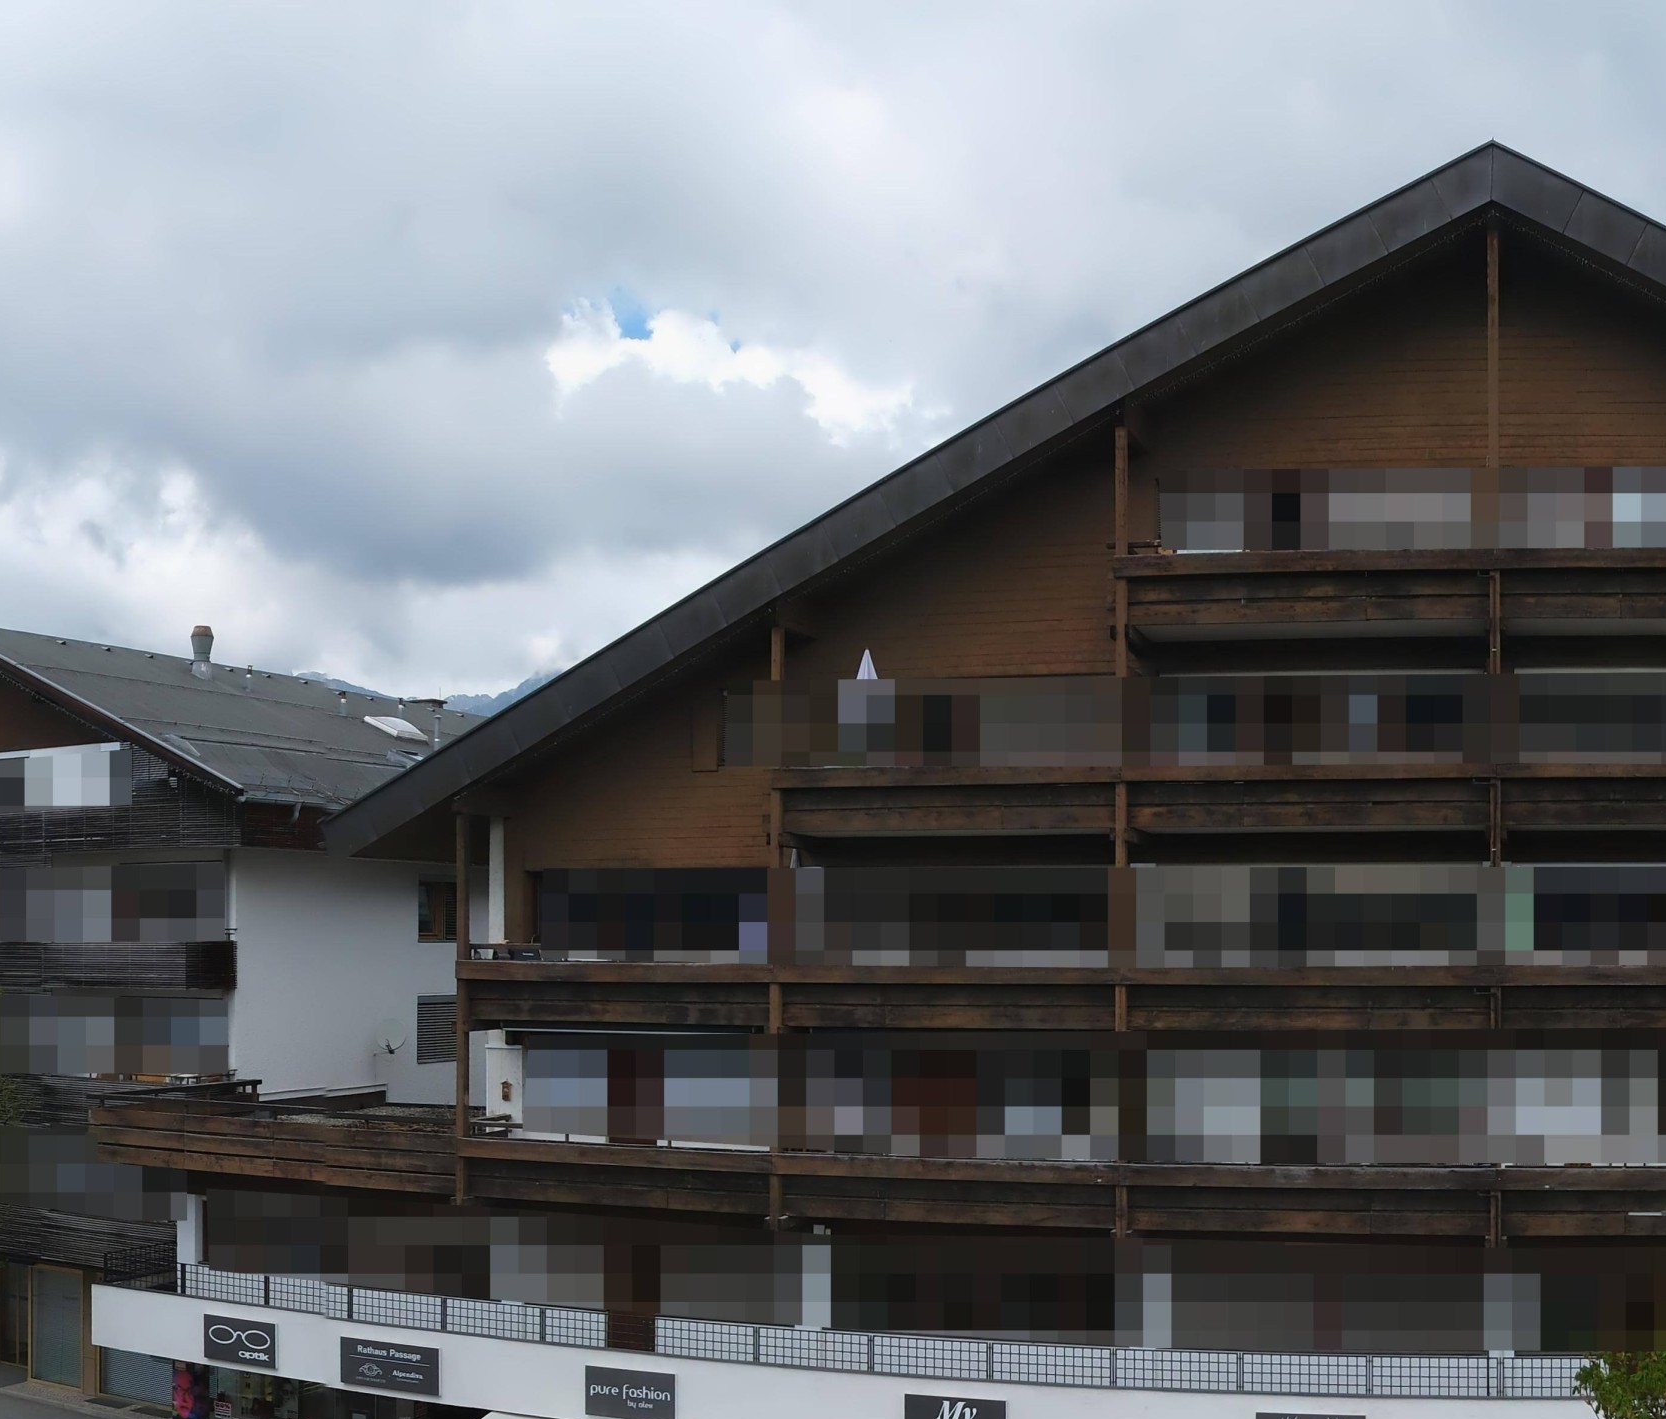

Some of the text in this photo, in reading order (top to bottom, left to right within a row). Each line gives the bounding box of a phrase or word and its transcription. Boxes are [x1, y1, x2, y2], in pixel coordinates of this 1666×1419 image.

[238, 1350, 270, 1362] optik
[357, 1345, 422, 1361] Rathaus Passage
[590, 1384, 671, 1401] pure fashion
[627, 1400, 653, 1409] by alex
